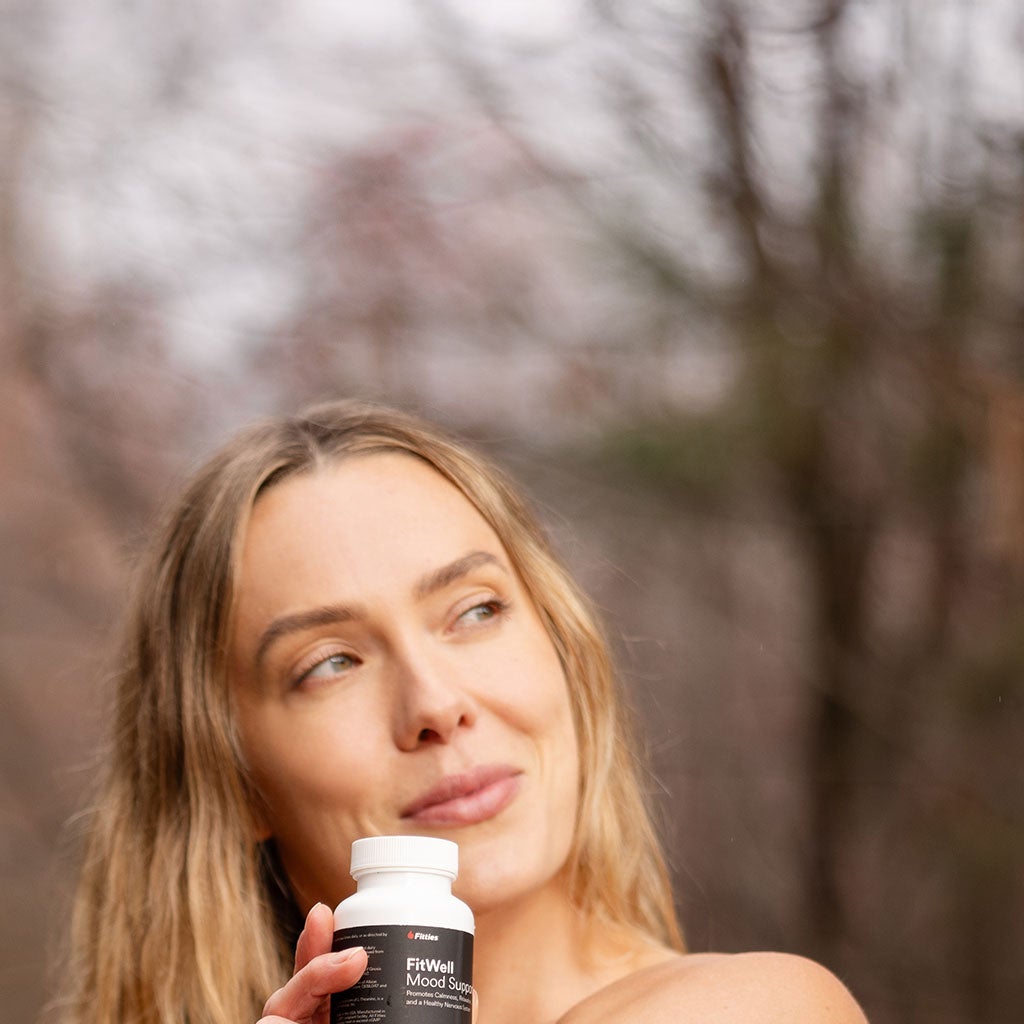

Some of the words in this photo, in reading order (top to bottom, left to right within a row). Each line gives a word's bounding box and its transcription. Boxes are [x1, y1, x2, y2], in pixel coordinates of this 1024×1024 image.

[414, 932, 439, 941] Fitties
[406, 957, 454, 974] FitWell
[406, 973, 446, 989] Mood
[406, 990, 434, 998] Promotes
[423, 999, 444, 1008] Healthy
